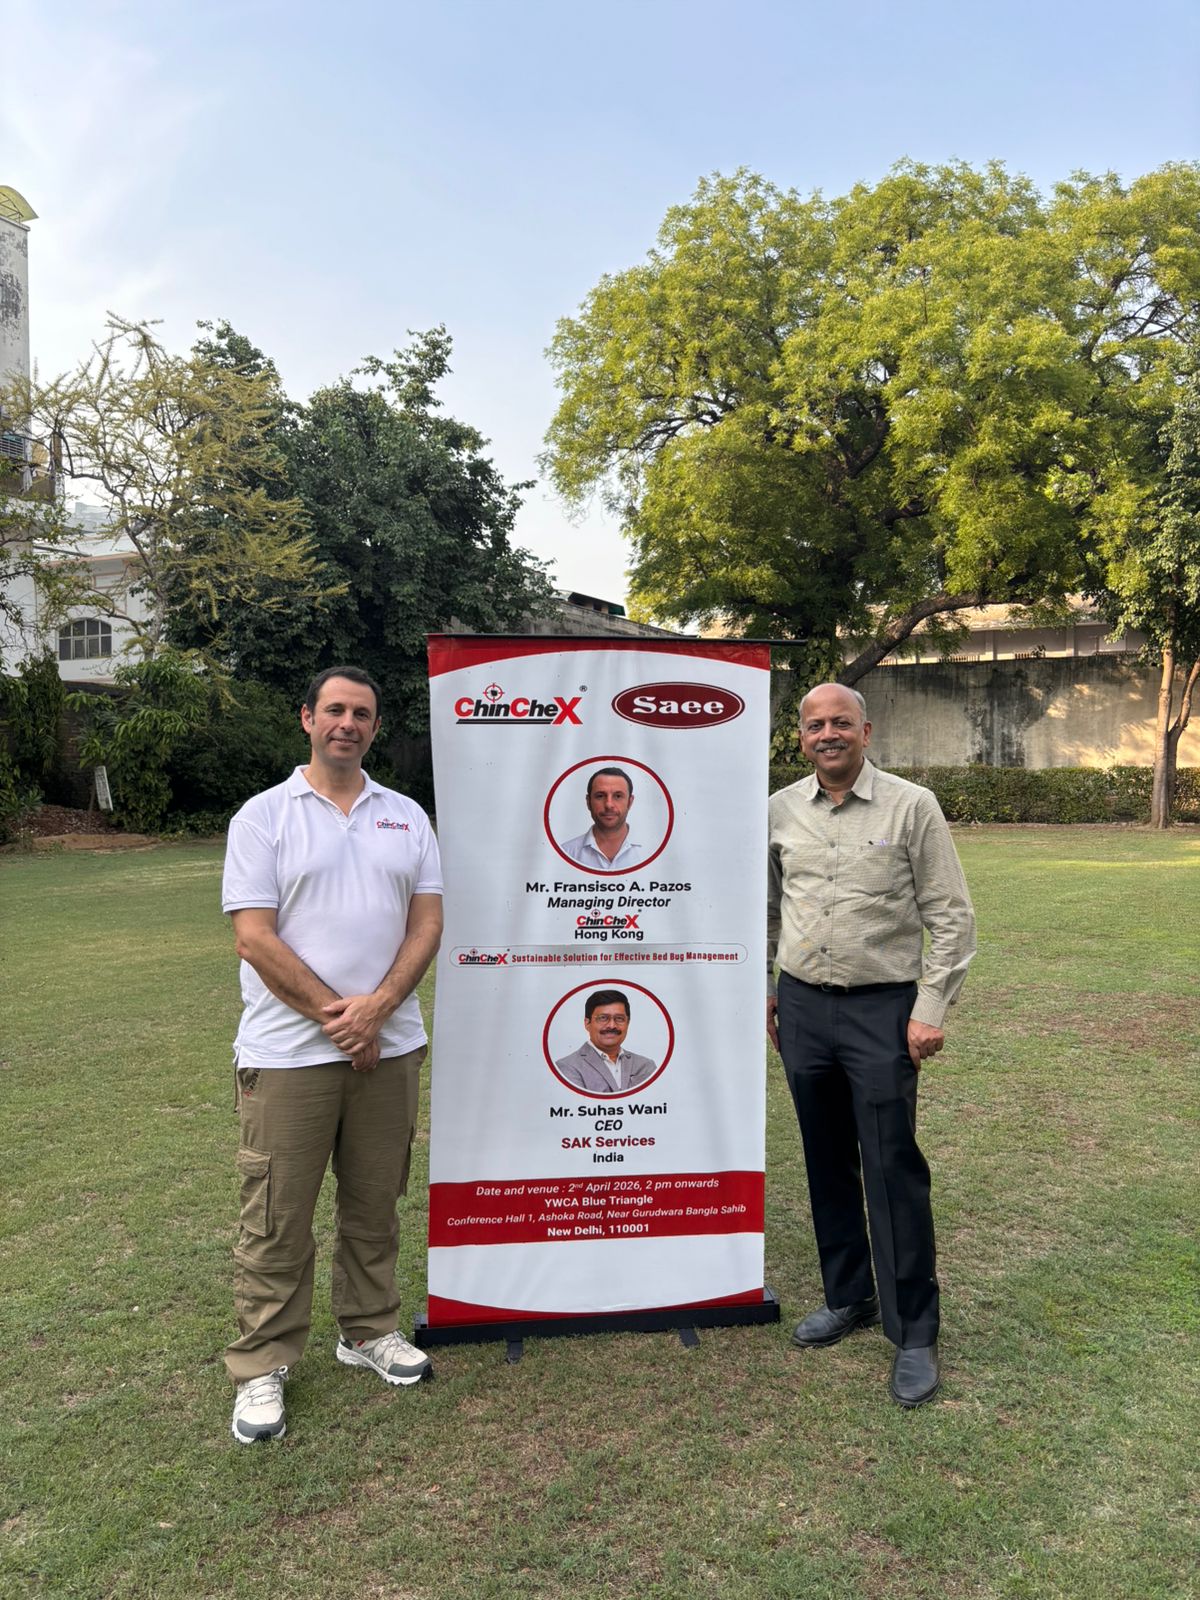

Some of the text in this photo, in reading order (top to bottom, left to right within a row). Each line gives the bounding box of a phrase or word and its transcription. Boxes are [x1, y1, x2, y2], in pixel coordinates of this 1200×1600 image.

[454, 696, 583, 725] ChinCheX
[632, 696, 724, 715] Saee
[526, 881, 692, 892] Mr. Fransisco A. Pazos
[547, 896, 671, 910] Managing Director
[576, 914, 639, 929] ChinCheX
[574, 929, 644, 941] Hong Kong
[511, 953, 561, 963] Sustainable
[563, 953, 598, 962] Solution
[600, 952, 612, 961] for
[614, 952, 651, 961] Effective
[652, 952, 668, 961] Bed
[670, 952, 684, 962] Bug
[686, 951, 739, 962] Management
[550, 1102, 667, 1117] Mr. Suhas Wani
[594, 1119, 623, 1131] CEO
[561, 1135, 656, 1149] SAK Services
[593, 1152, 624, 1163] India
[476, 1186, 501, 1196] Date
[504, 1185, 525, 1195] and
[527, 1185, 559, 1194] venue
[585, 1182, 611, 1193] April
[613, 1180, 642, 1191] 2026,
[645, 1180, 653, 1190] 2
[654, 1181, 672, 1191] pm
[674, 1178, 720, 1189] onwards
[545, 1195, 654, 1208] YWCA Blue Triangle
[447, 1204, 746, 1226] Conference Hall 1, Ashoka Road, Near Gurudwara Bangla Sahib
[547, 1223, 650, 1237] New Delhi, 110001
